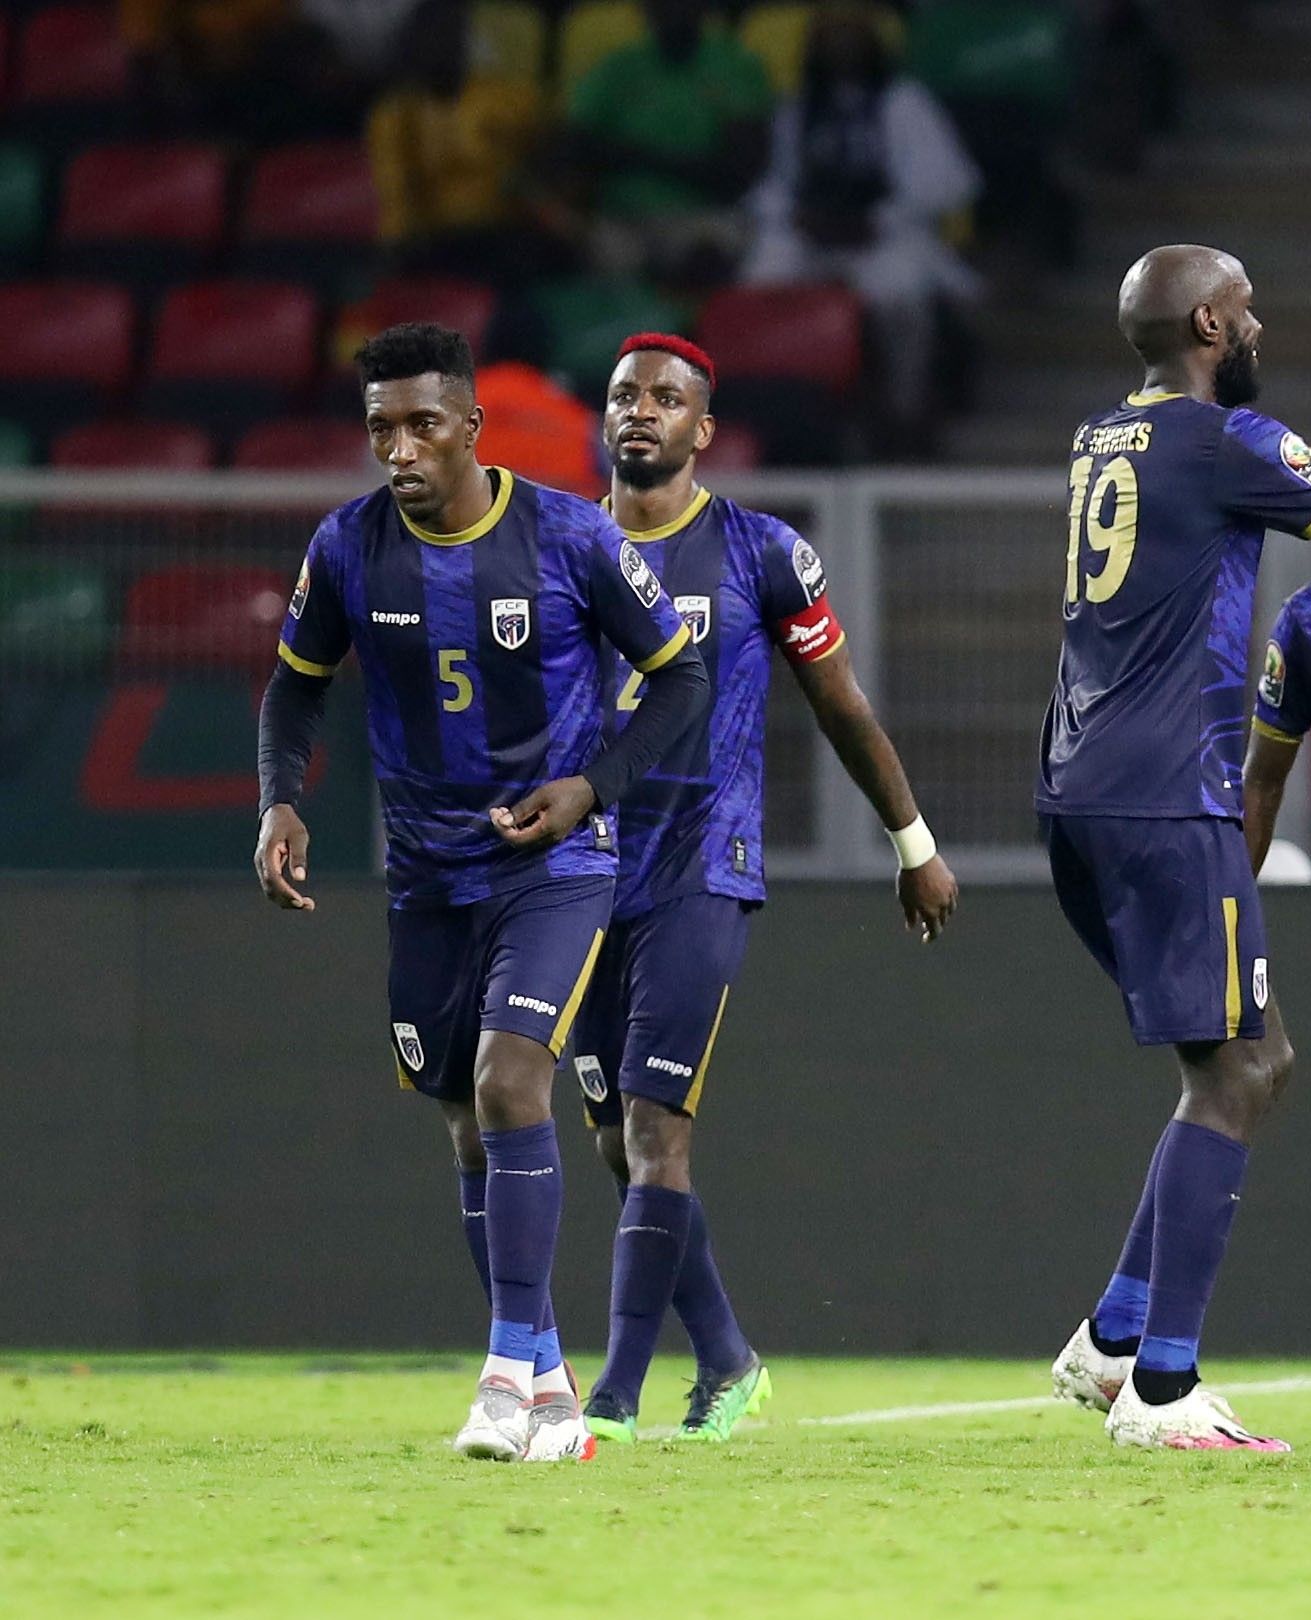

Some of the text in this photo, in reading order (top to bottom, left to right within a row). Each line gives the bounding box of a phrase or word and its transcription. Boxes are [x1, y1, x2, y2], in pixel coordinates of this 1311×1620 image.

[1067, 455, 1139, 604] 19
[494, 601, 525, 610] FCF
[371, 610, 420, 626] tempo
[438, 649, 474, 712] 5
[508, 993, 558, 1017] tempo
[646, 1056, 693, 1077] tempo
